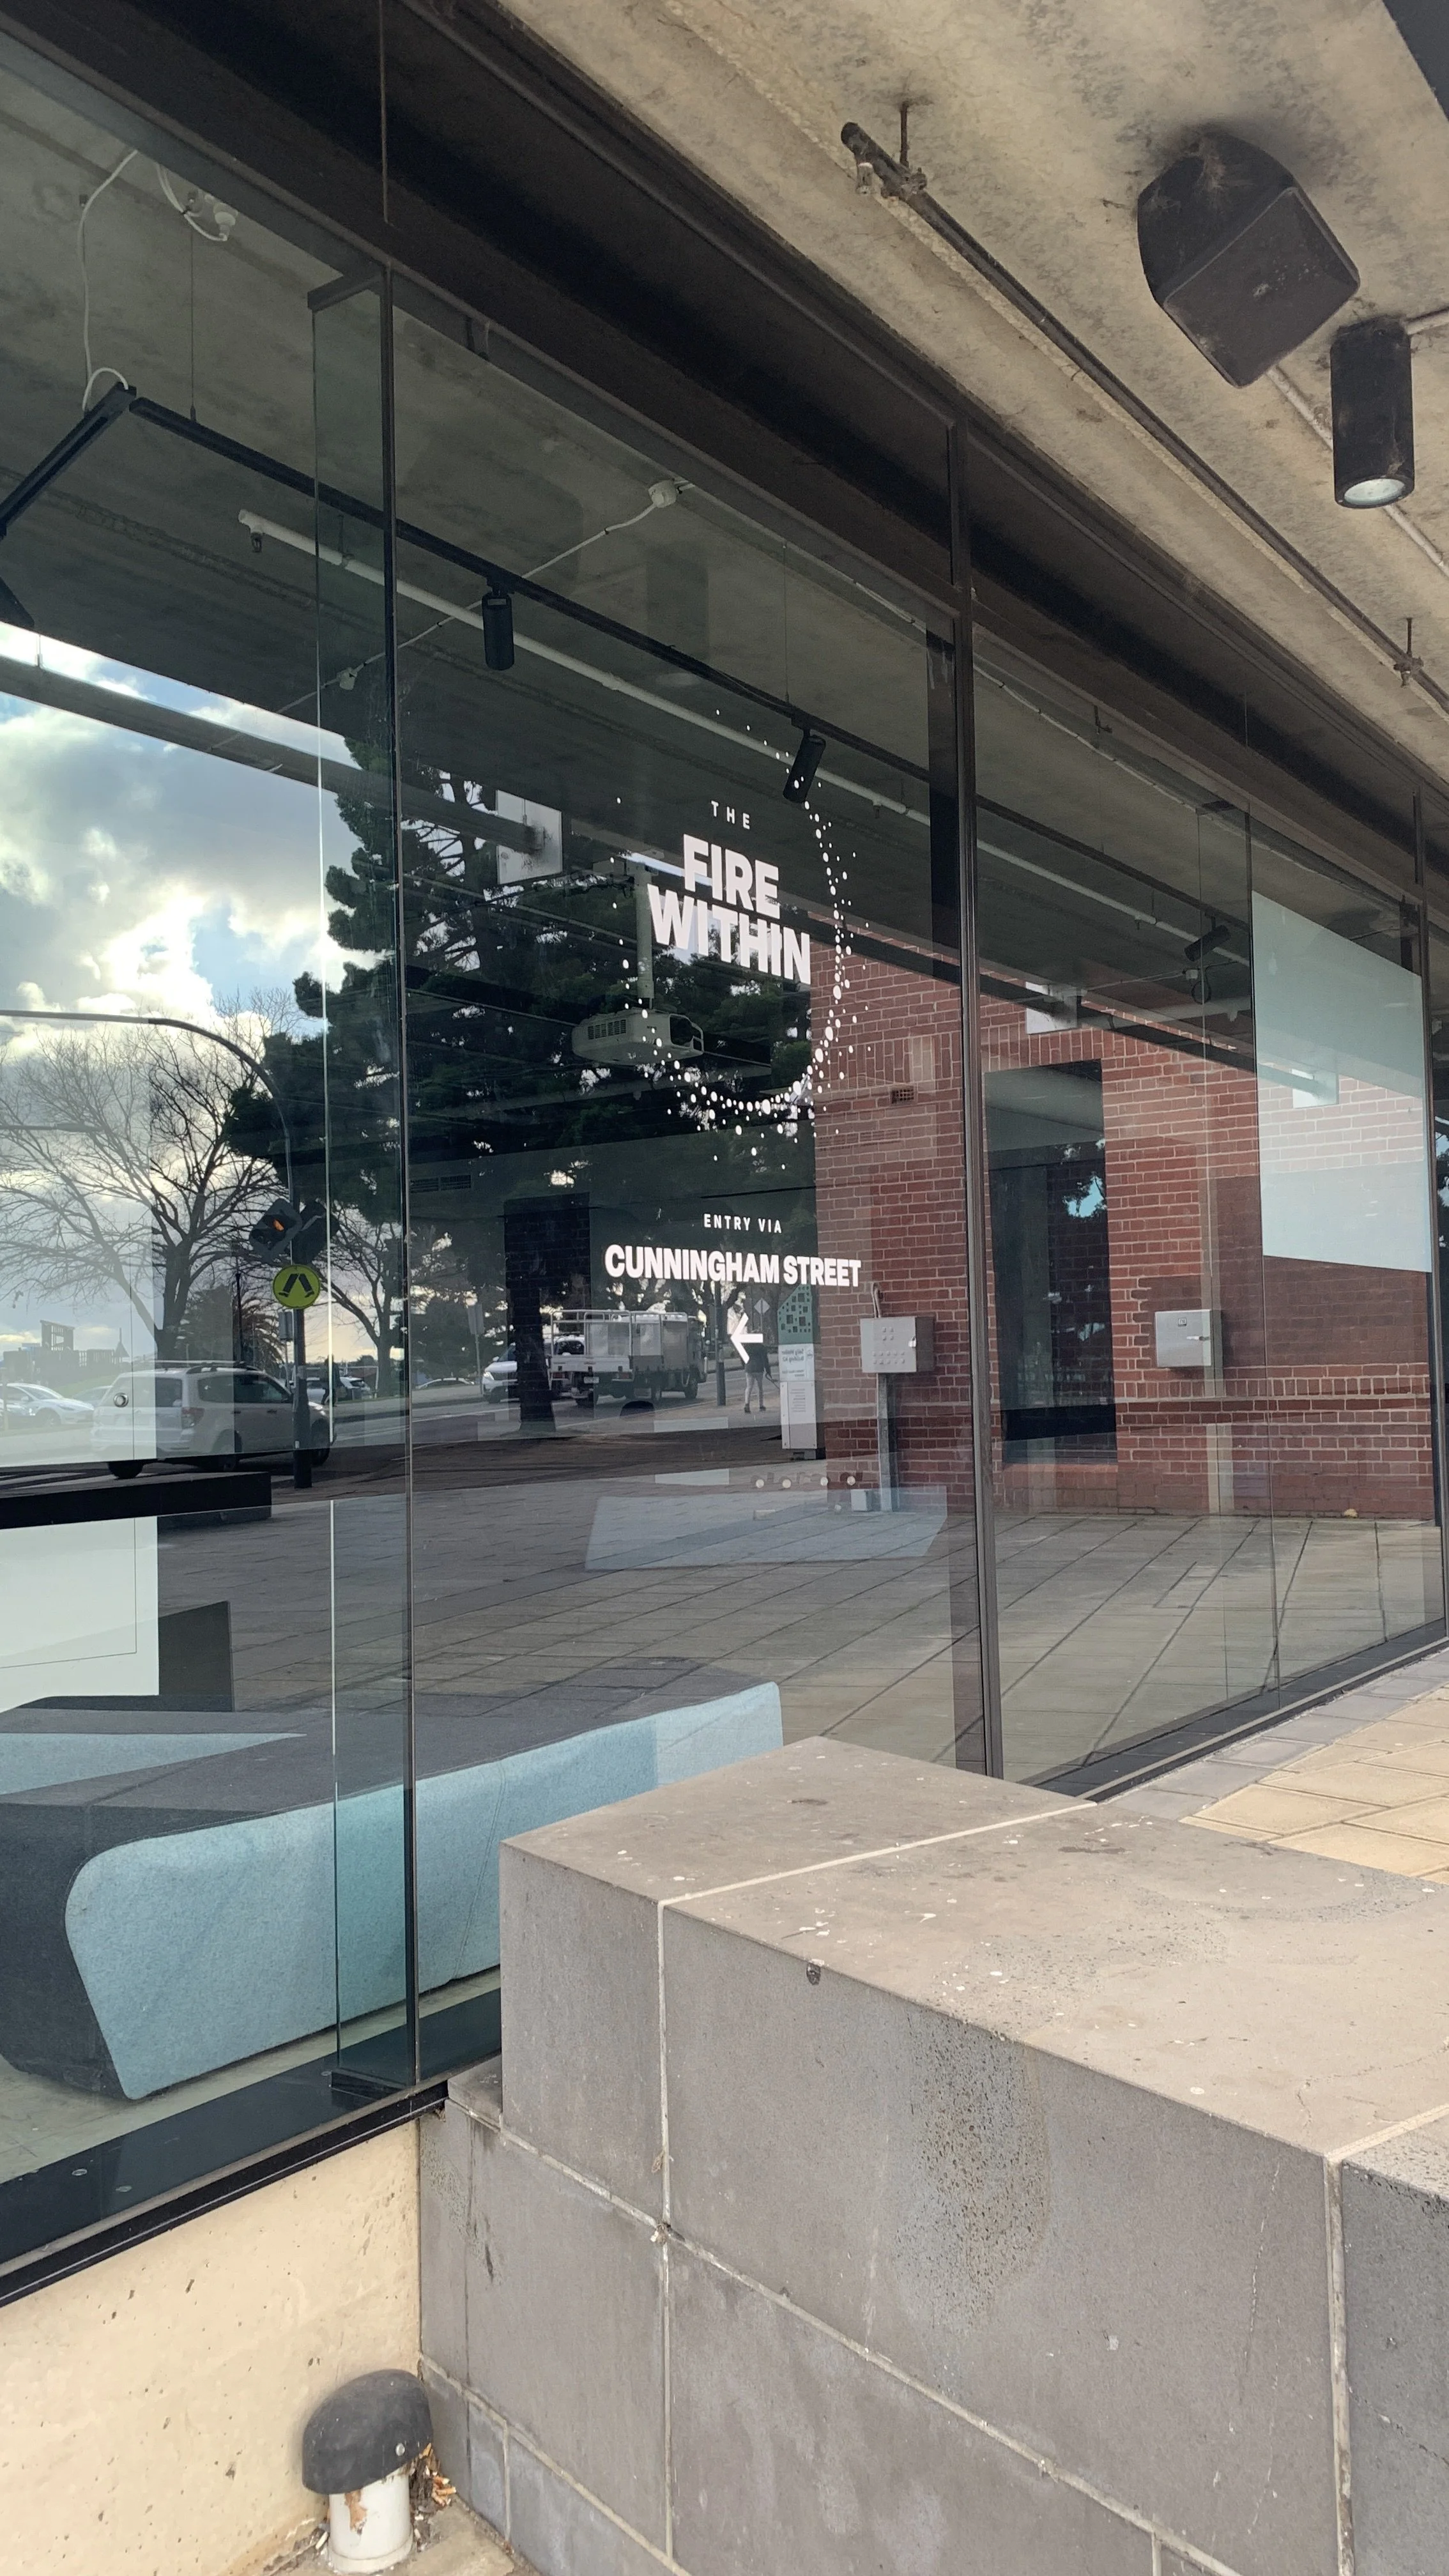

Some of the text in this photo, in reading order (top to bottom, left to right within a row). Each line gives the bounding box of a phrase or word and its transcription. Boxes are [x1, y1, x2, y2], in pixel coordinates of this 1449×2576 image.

[711, 801, 750, 829] THE
[683, 834, 780, 919] FIRE
[647, 884, 811, 985] WITHIN
[703, 1213, 782, 1234] ENTRY VIA
[605, 1244, 861, 1287] CUNNINGHAM STREET
